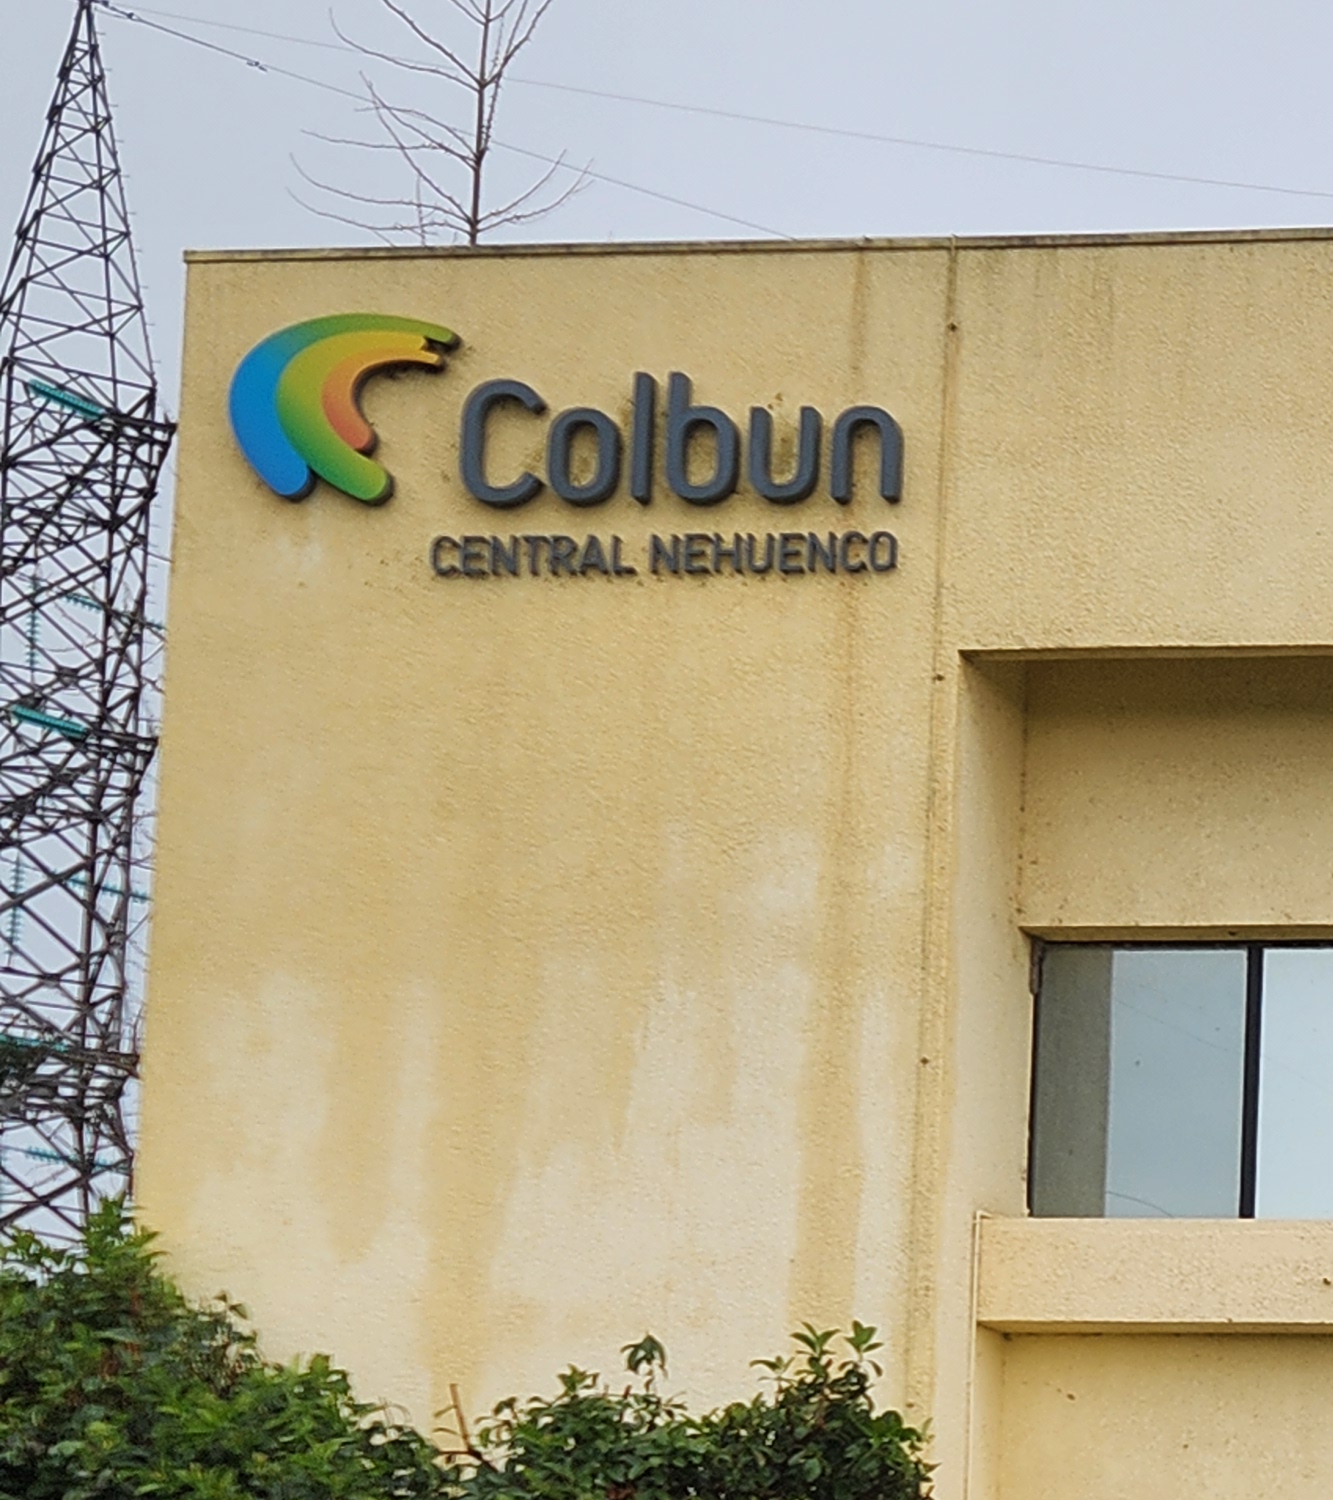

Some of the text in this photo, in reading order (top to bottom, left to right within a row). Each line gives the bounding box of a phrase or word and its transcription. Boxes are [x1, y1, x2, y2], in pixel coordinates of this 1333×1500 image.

[459, 371, 905, 509] Colbun
[431, 530, 899, 577] CENTRAL NEHUENCO
